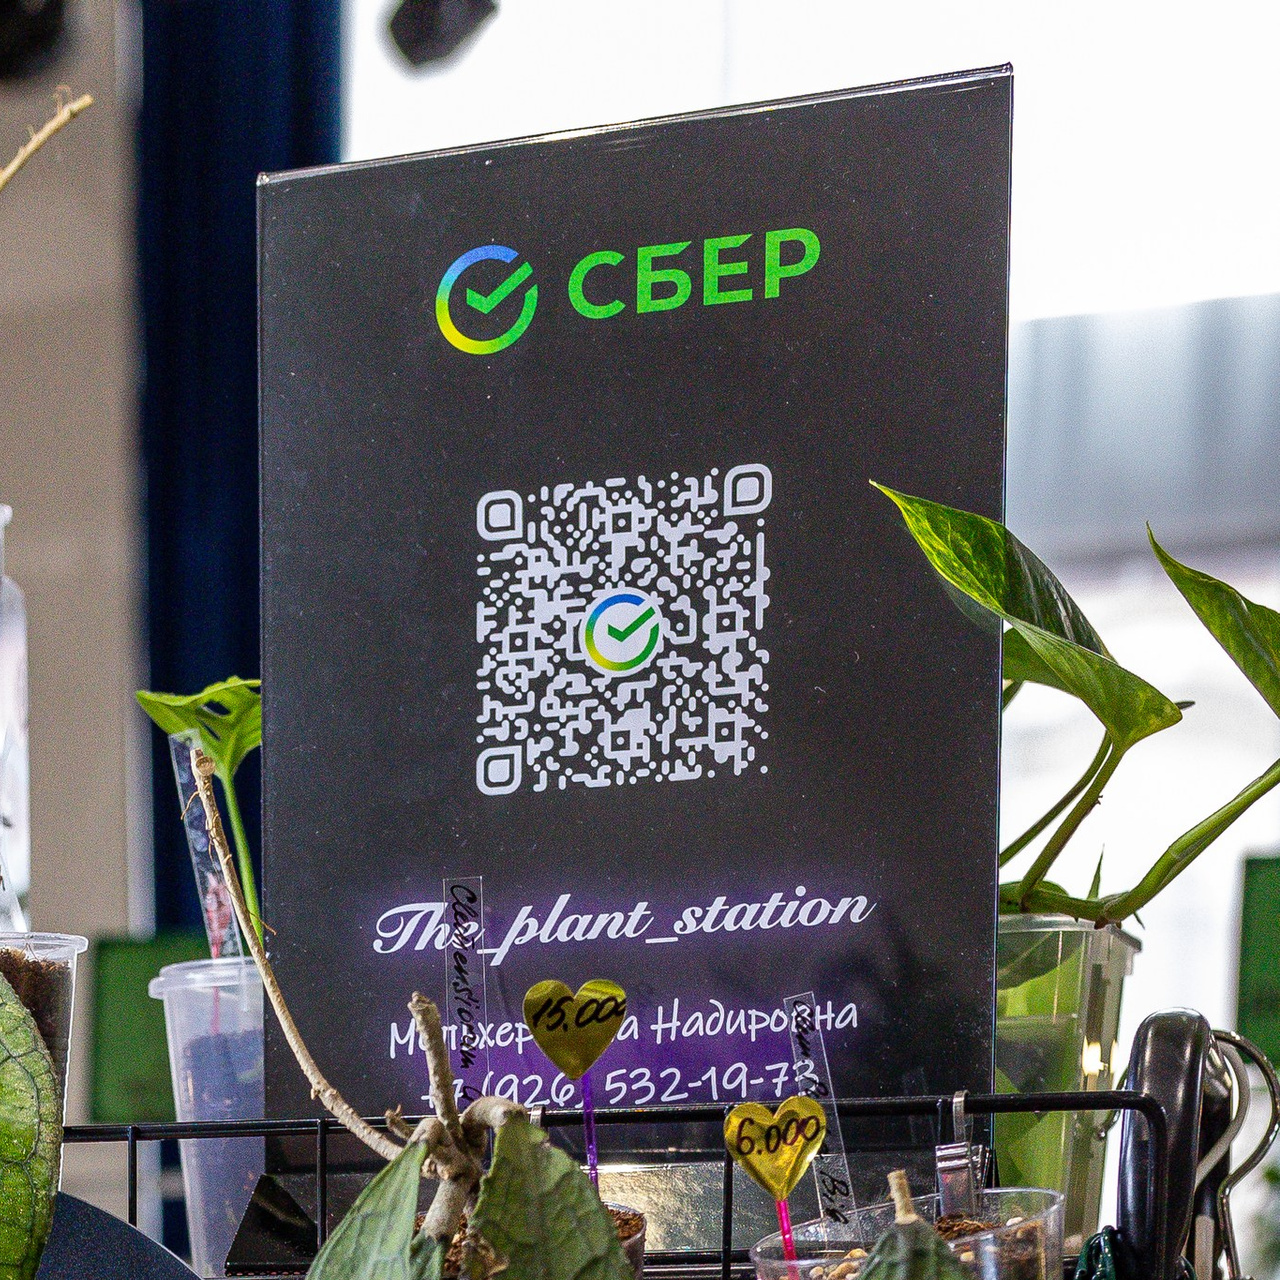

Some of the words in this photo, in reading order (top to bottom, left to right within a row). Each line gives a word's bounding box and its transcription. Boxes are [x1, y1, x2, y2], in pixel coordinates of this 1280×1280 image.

[567, 227, 821, 320] СБЕР
[372, 884, 877, 966] The_plant_station
[650, 998, 858, 1045] Надировна
[737, 1115, 820, 1156] 6.000
